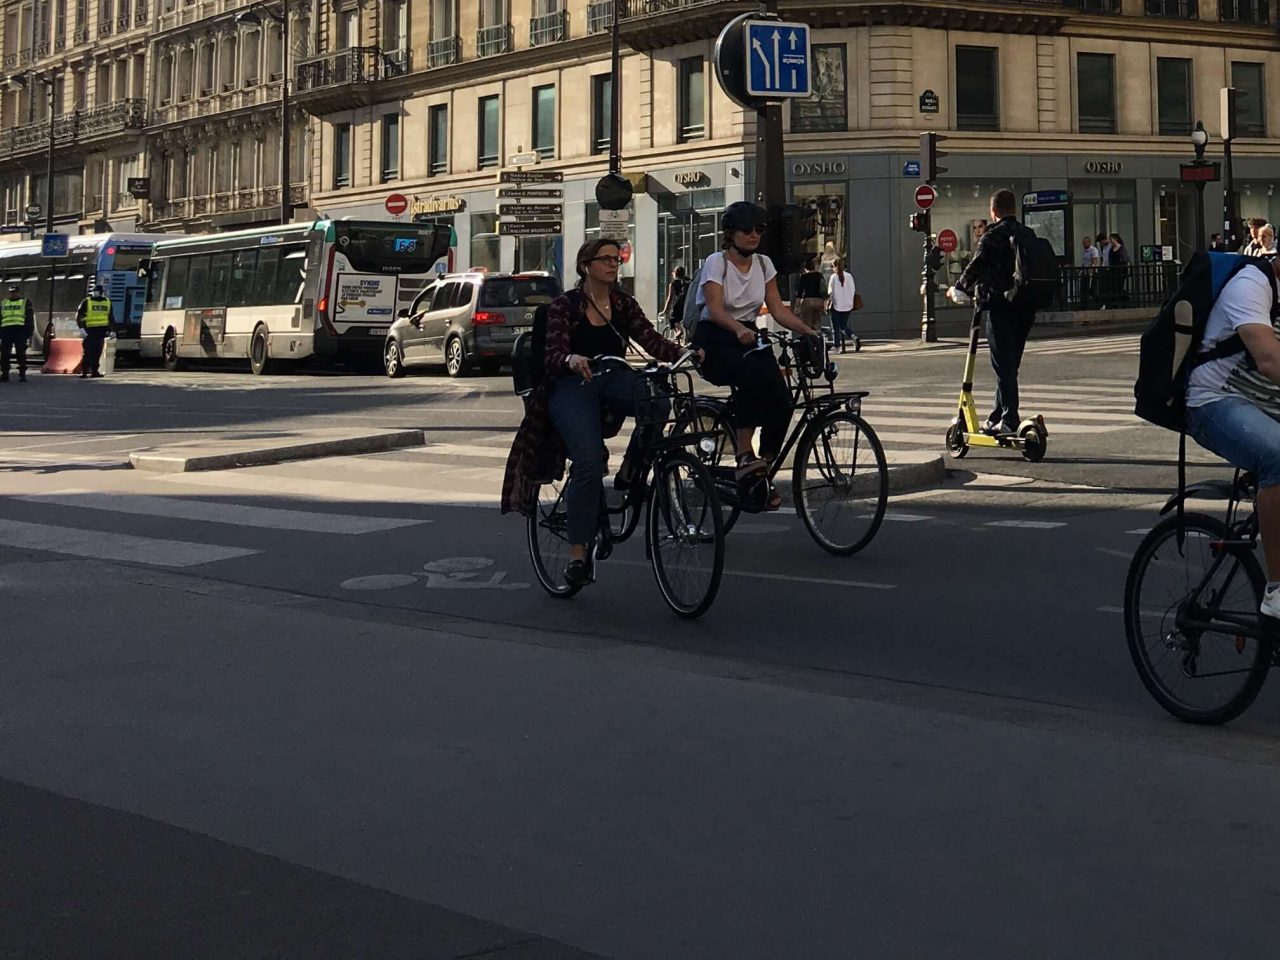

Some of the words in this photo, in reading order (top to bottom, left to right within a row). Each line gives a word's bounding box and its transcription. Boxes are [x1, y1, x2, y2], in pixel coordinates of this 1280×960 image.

[792, 161, 846, 176] OYSHO
[1086, 160, 1124, 174] OYSHO
[675, 171, 700, 184] OYSHO
